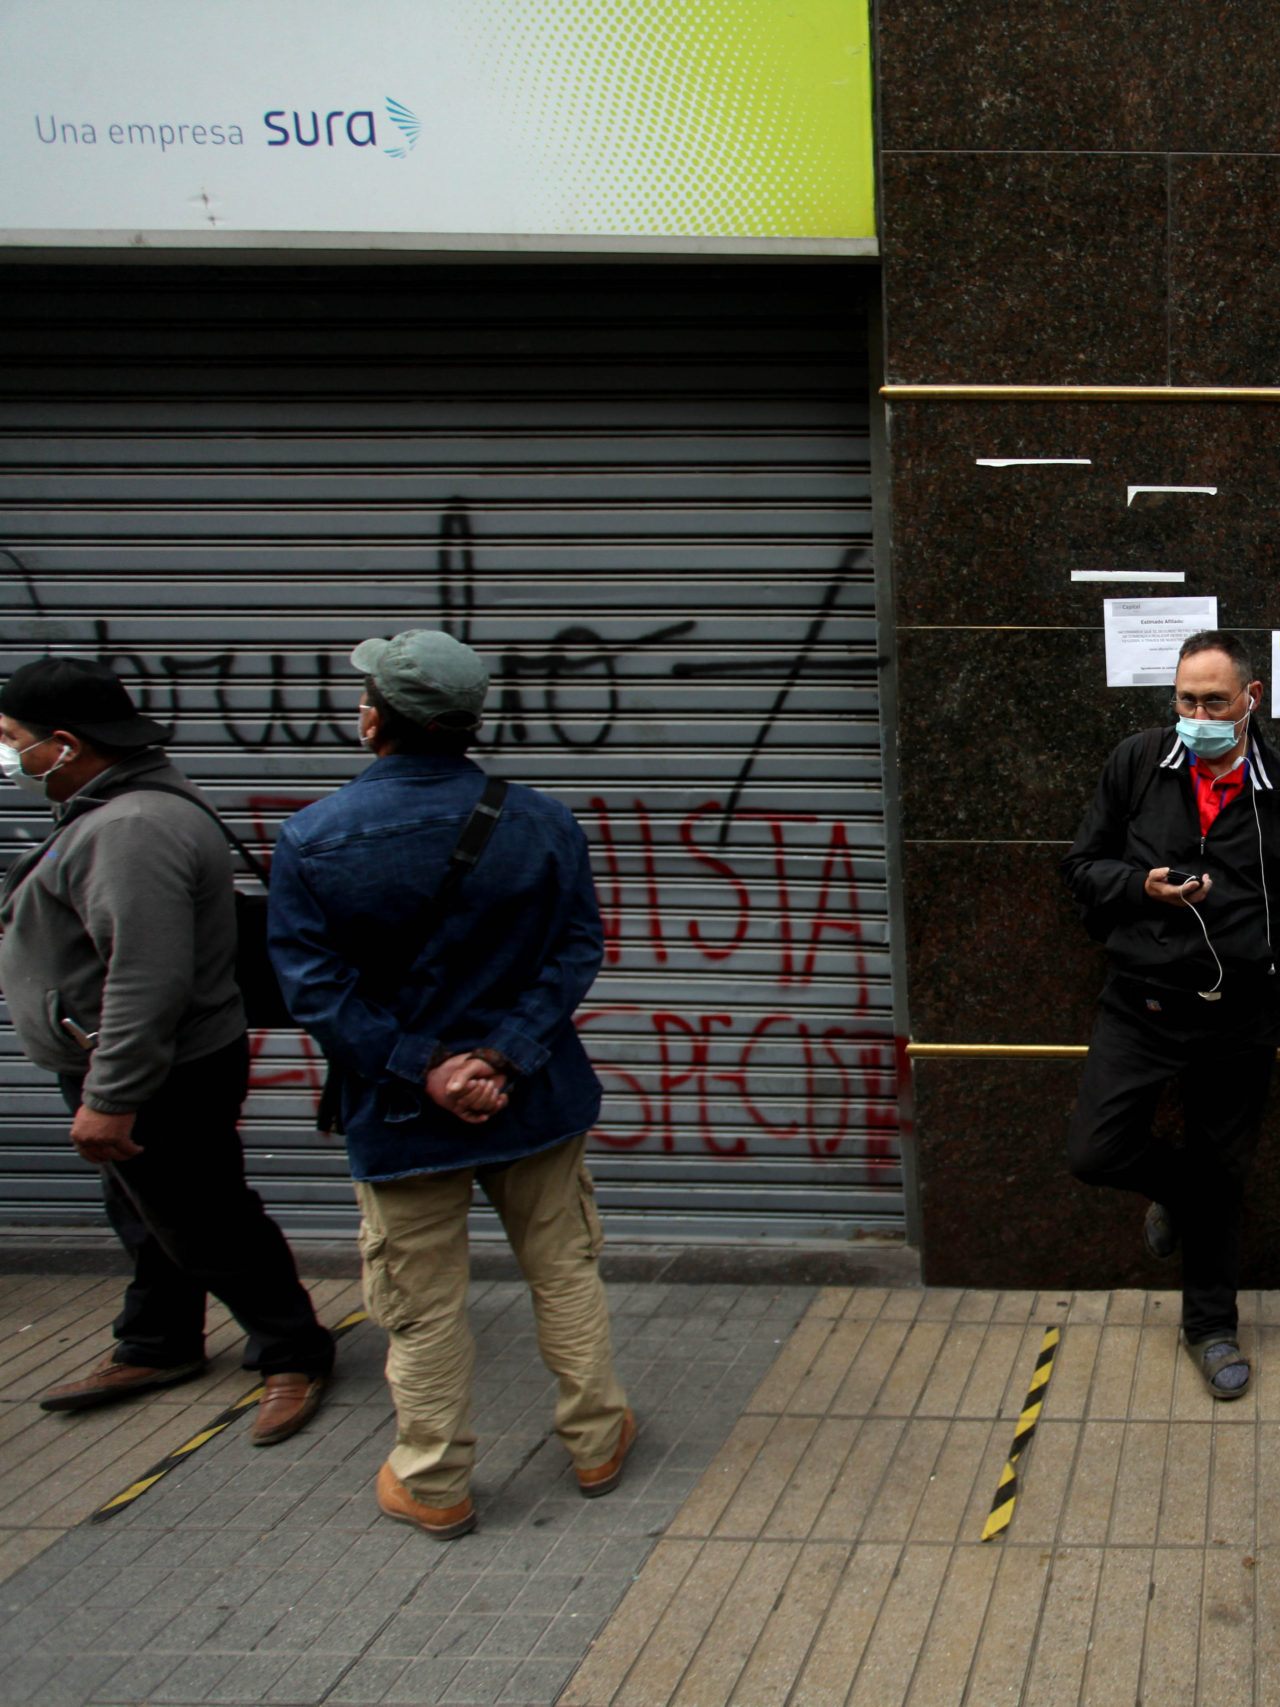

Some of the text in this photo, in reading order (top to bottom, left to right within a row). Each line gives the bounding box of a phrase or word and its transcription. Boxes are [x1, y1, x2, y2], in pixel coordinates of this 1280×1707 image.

[34, 110, 376, 152] Una empresa sura
